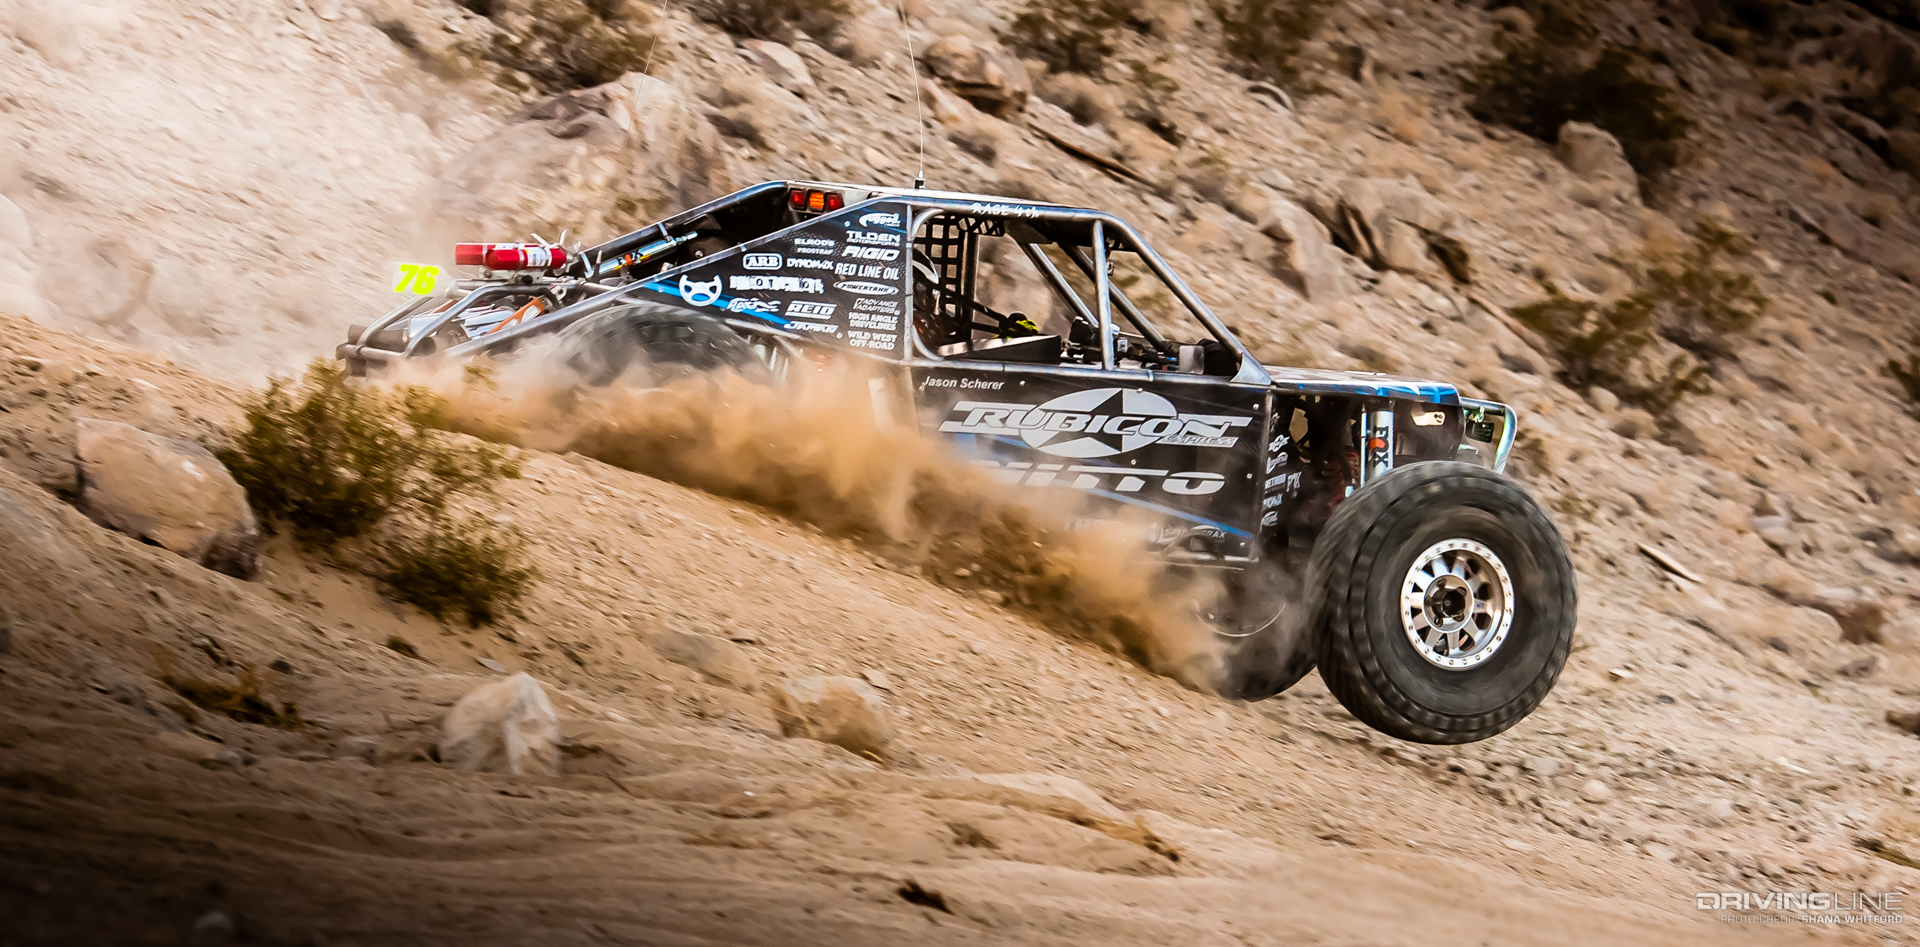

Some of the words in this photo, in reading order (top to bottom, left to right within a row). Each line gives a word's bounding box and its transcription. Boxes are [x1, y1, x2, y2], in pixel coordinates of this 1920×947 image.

[846, 230, 900, 243] TILDEN
[795, 239, 835, 247] ELROD'S
[842, 245, 900, 261] RIGID
[748, 256, 778, 267] ARB
[787, 258, 834, 270] DYNOMAX
[834, 263, 857, 276] RED
[858, 265, 882, 278] LINE
[883, 267, 900, 280] OIL
[393, 264, 440, 294] 76
[862, 298, 898, 308] ADVANCE
[788, 304, 835, 315] REID
[848, 312, 870, 321] HIGH
[871, 314, 898, 323] ANGLE
[847, 330, 871, 340] WILD
[872, 332, 897, 343] WEST
[849, 339, 894, 350] OFF-ROAD
[924, 375, 958, 388] Jason
[959, 377, 1004, 390] Scherer
[962, 407, 1231, 437] RUBICON
